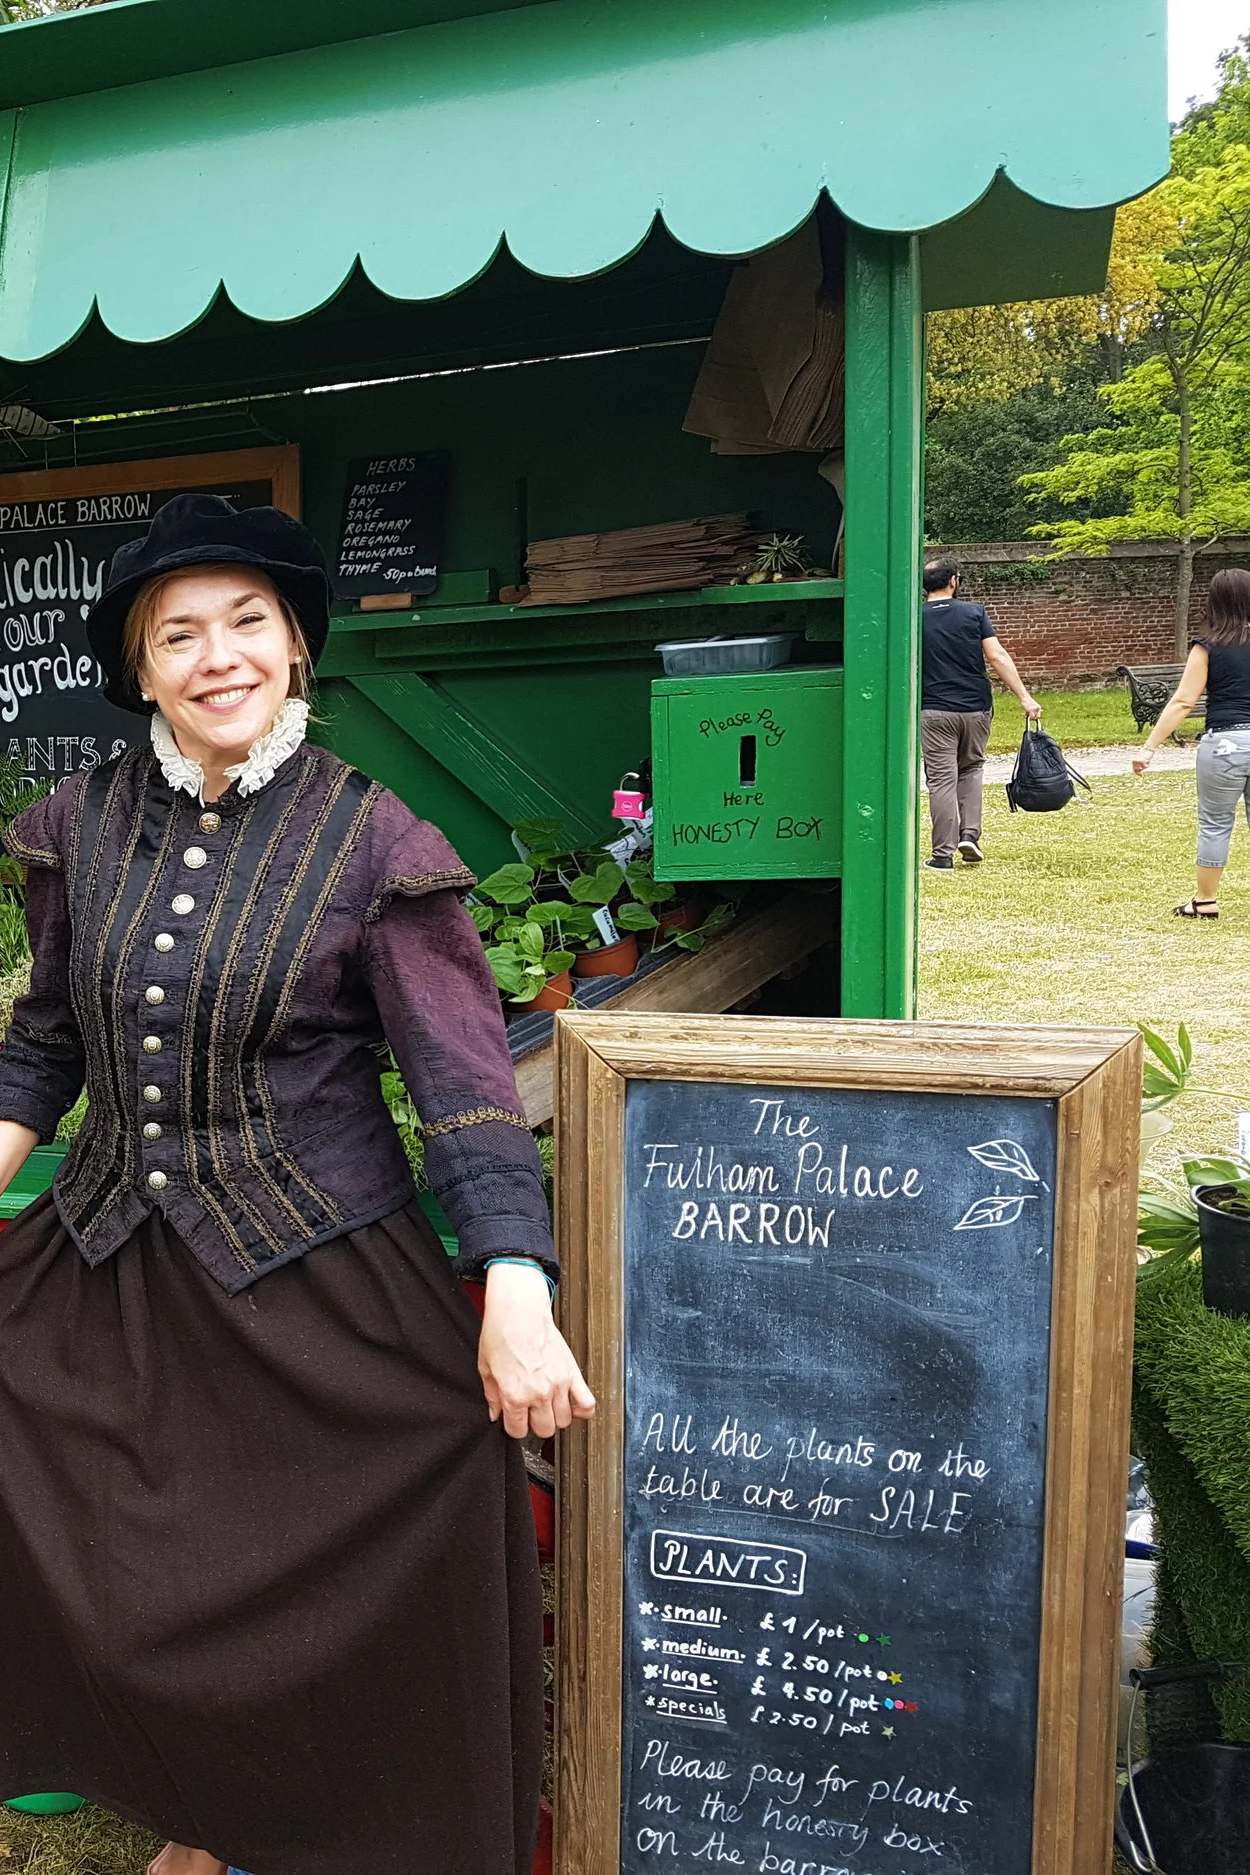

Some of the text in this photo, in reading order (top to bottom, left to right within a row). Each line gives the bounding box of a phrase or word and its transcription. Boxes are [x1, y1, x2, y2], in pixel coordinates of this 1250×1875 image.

[366, 458, 416, 476] HERBS
[348, 497, 376, 509] BAY
[351, 481, 406, 496] PARSLEY
[0, 501, 67, 529] PALACE
[76, 493, 151, 521] BARROW
[345, 519, 412, 535] ROSEMARY
[347, 508, 384, 521] SAGE
[340, 546, 416, 560] LEMONGRASS
[342, 535, 400, 547] OREGANO
[339, 562, 382, 576] THYME
[4, 608, 65, 651] our
[699, 708, 786, 747] Please Pay
[723, 791, 764, 808] Here
[672, 817, 760, 846] HONESTY
[776, 816, 824, 840] BOX
[749, 1098, 819, 1138] The
[644, 1142, 923, 1198] Fulham Palace
[672, 1201, 835, 1248] BARROW
[643, 1412, 991, 1482] All the plants on the
[644, 1465, 972, 1533] table are for SALE
[658, 1539, 799, 1585] PLANTS:
[640, 1739, 974, 1821] Please pay for plants
[638, 1791, 946, 1857] in the honesty box
[637, 1828, 679, 1856] on
[692, 1829, 745, 1865] the
